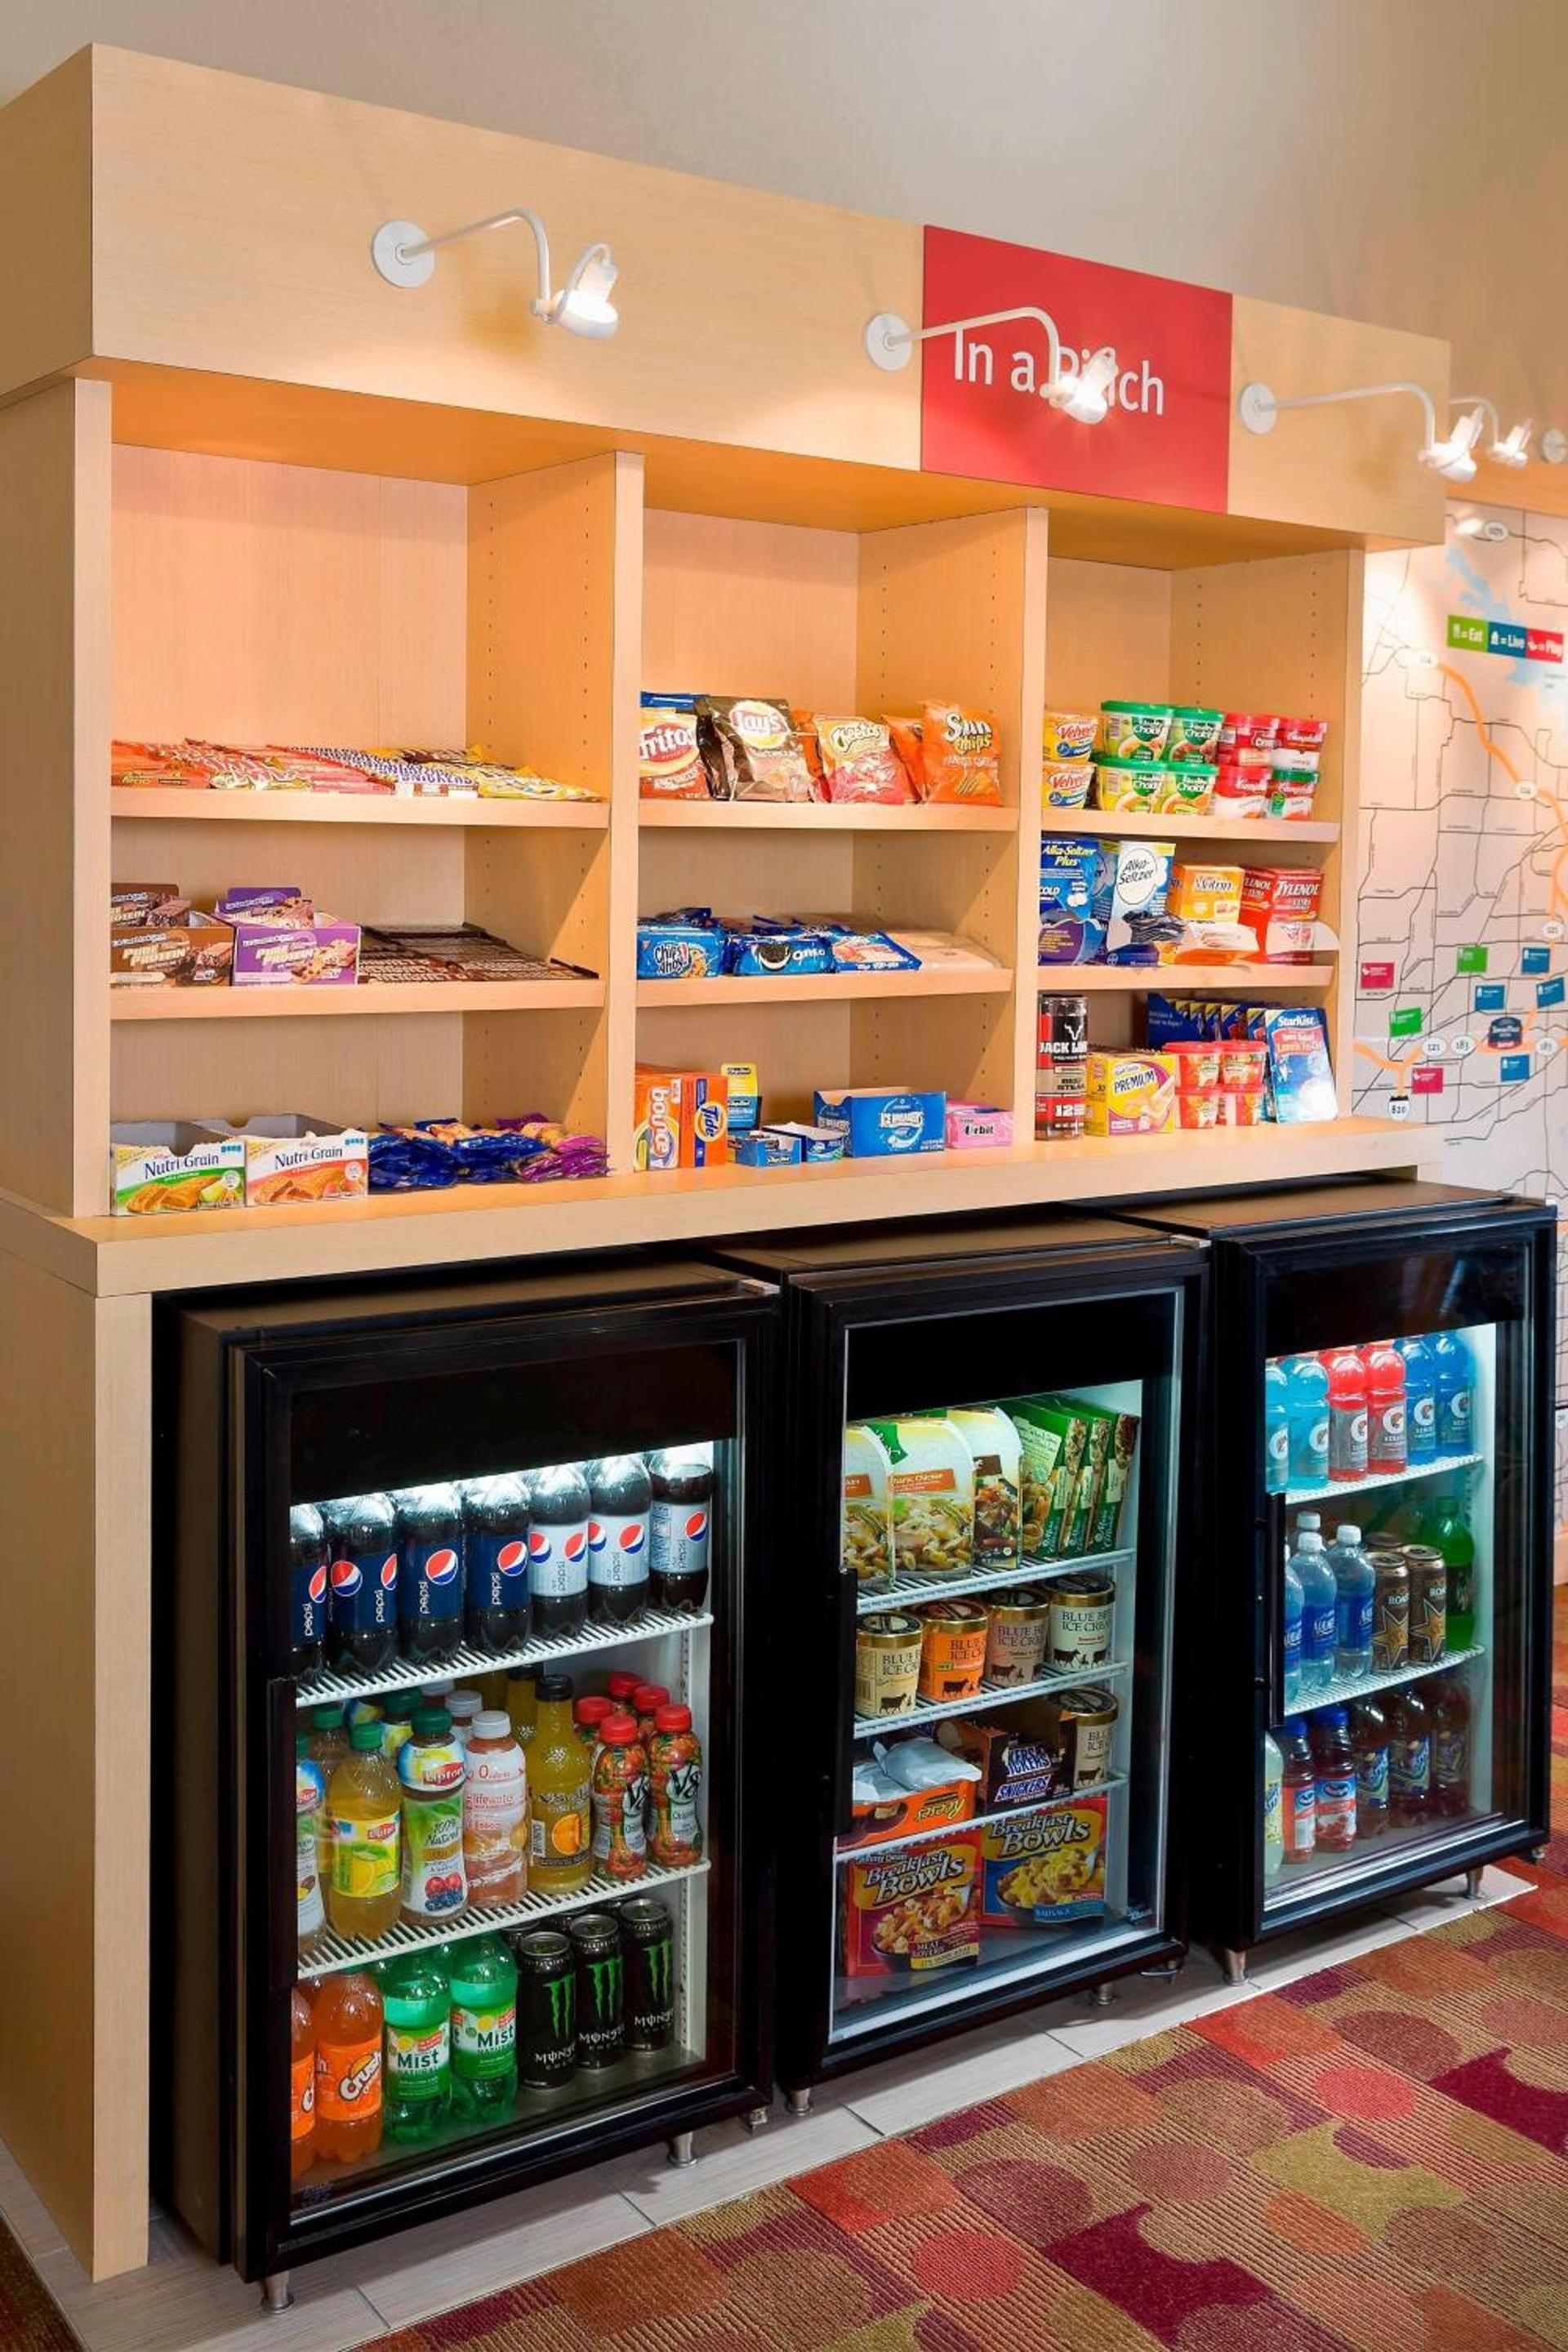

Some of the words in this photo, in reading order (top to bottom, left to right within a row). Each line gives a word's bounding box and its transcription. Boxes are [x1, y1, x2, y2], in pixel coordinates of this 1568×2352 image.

[947, 326, 993, 385] In
[1010, 351, 1035, 394] a
[1053, 345, 1165, 415] Pch
[1468, 628, 1483, 643] Eat
[1508, 634, 1526, 649] Live
[945, 711, 992, 741] Sun
[1043, 844, 1097, 857] Alka-Seltzer
[1054, 856, 1078, 866] Plus
[1276, 880, 1319, 897] TYLENOL
[1040, 1041, 1070, 1054] JACK
[1455, 1040, 1469, 1050] 183
[1113, 1070, 1156, 1094] PREMIUM
[702, 1106, 719, 1138] Tide
[556, 1561, 567, 1592] pepsi
[419, 1580, 430, 1615] pepsi
[490, 1572, 501, 1606] pepsi
[374, 1588, 385, 1624] pepsi
[1062, 1610, 1095, 1623] BLUE
[302, 1601, 314, 1637] pepsi
[998, 1624, 1031, 1637] BLUE
[1062, 1621, 1082, 1632] ICE
[998, 1635, 1018, 1647] ICE
[951, 1648, 969, 1660] ICE
[883, 1664, 902, 1676] ICE
[424, 1764, 464, 1784] Lipton
[670, 1762, 702, 1798] V8
[998, 1775, 1050, 1799] SNICKERS
[991, 1813, 1071, 1838] Breakfast
[1000, 1818, 1090, 1856] Bowls
[866, 1850, 947, 1886] Breakfast
[875, 1856, 964, 1905] Bowls
[478, 2025, 514, 2048] Mist
[397, 2049, 439, 2069] Mist
